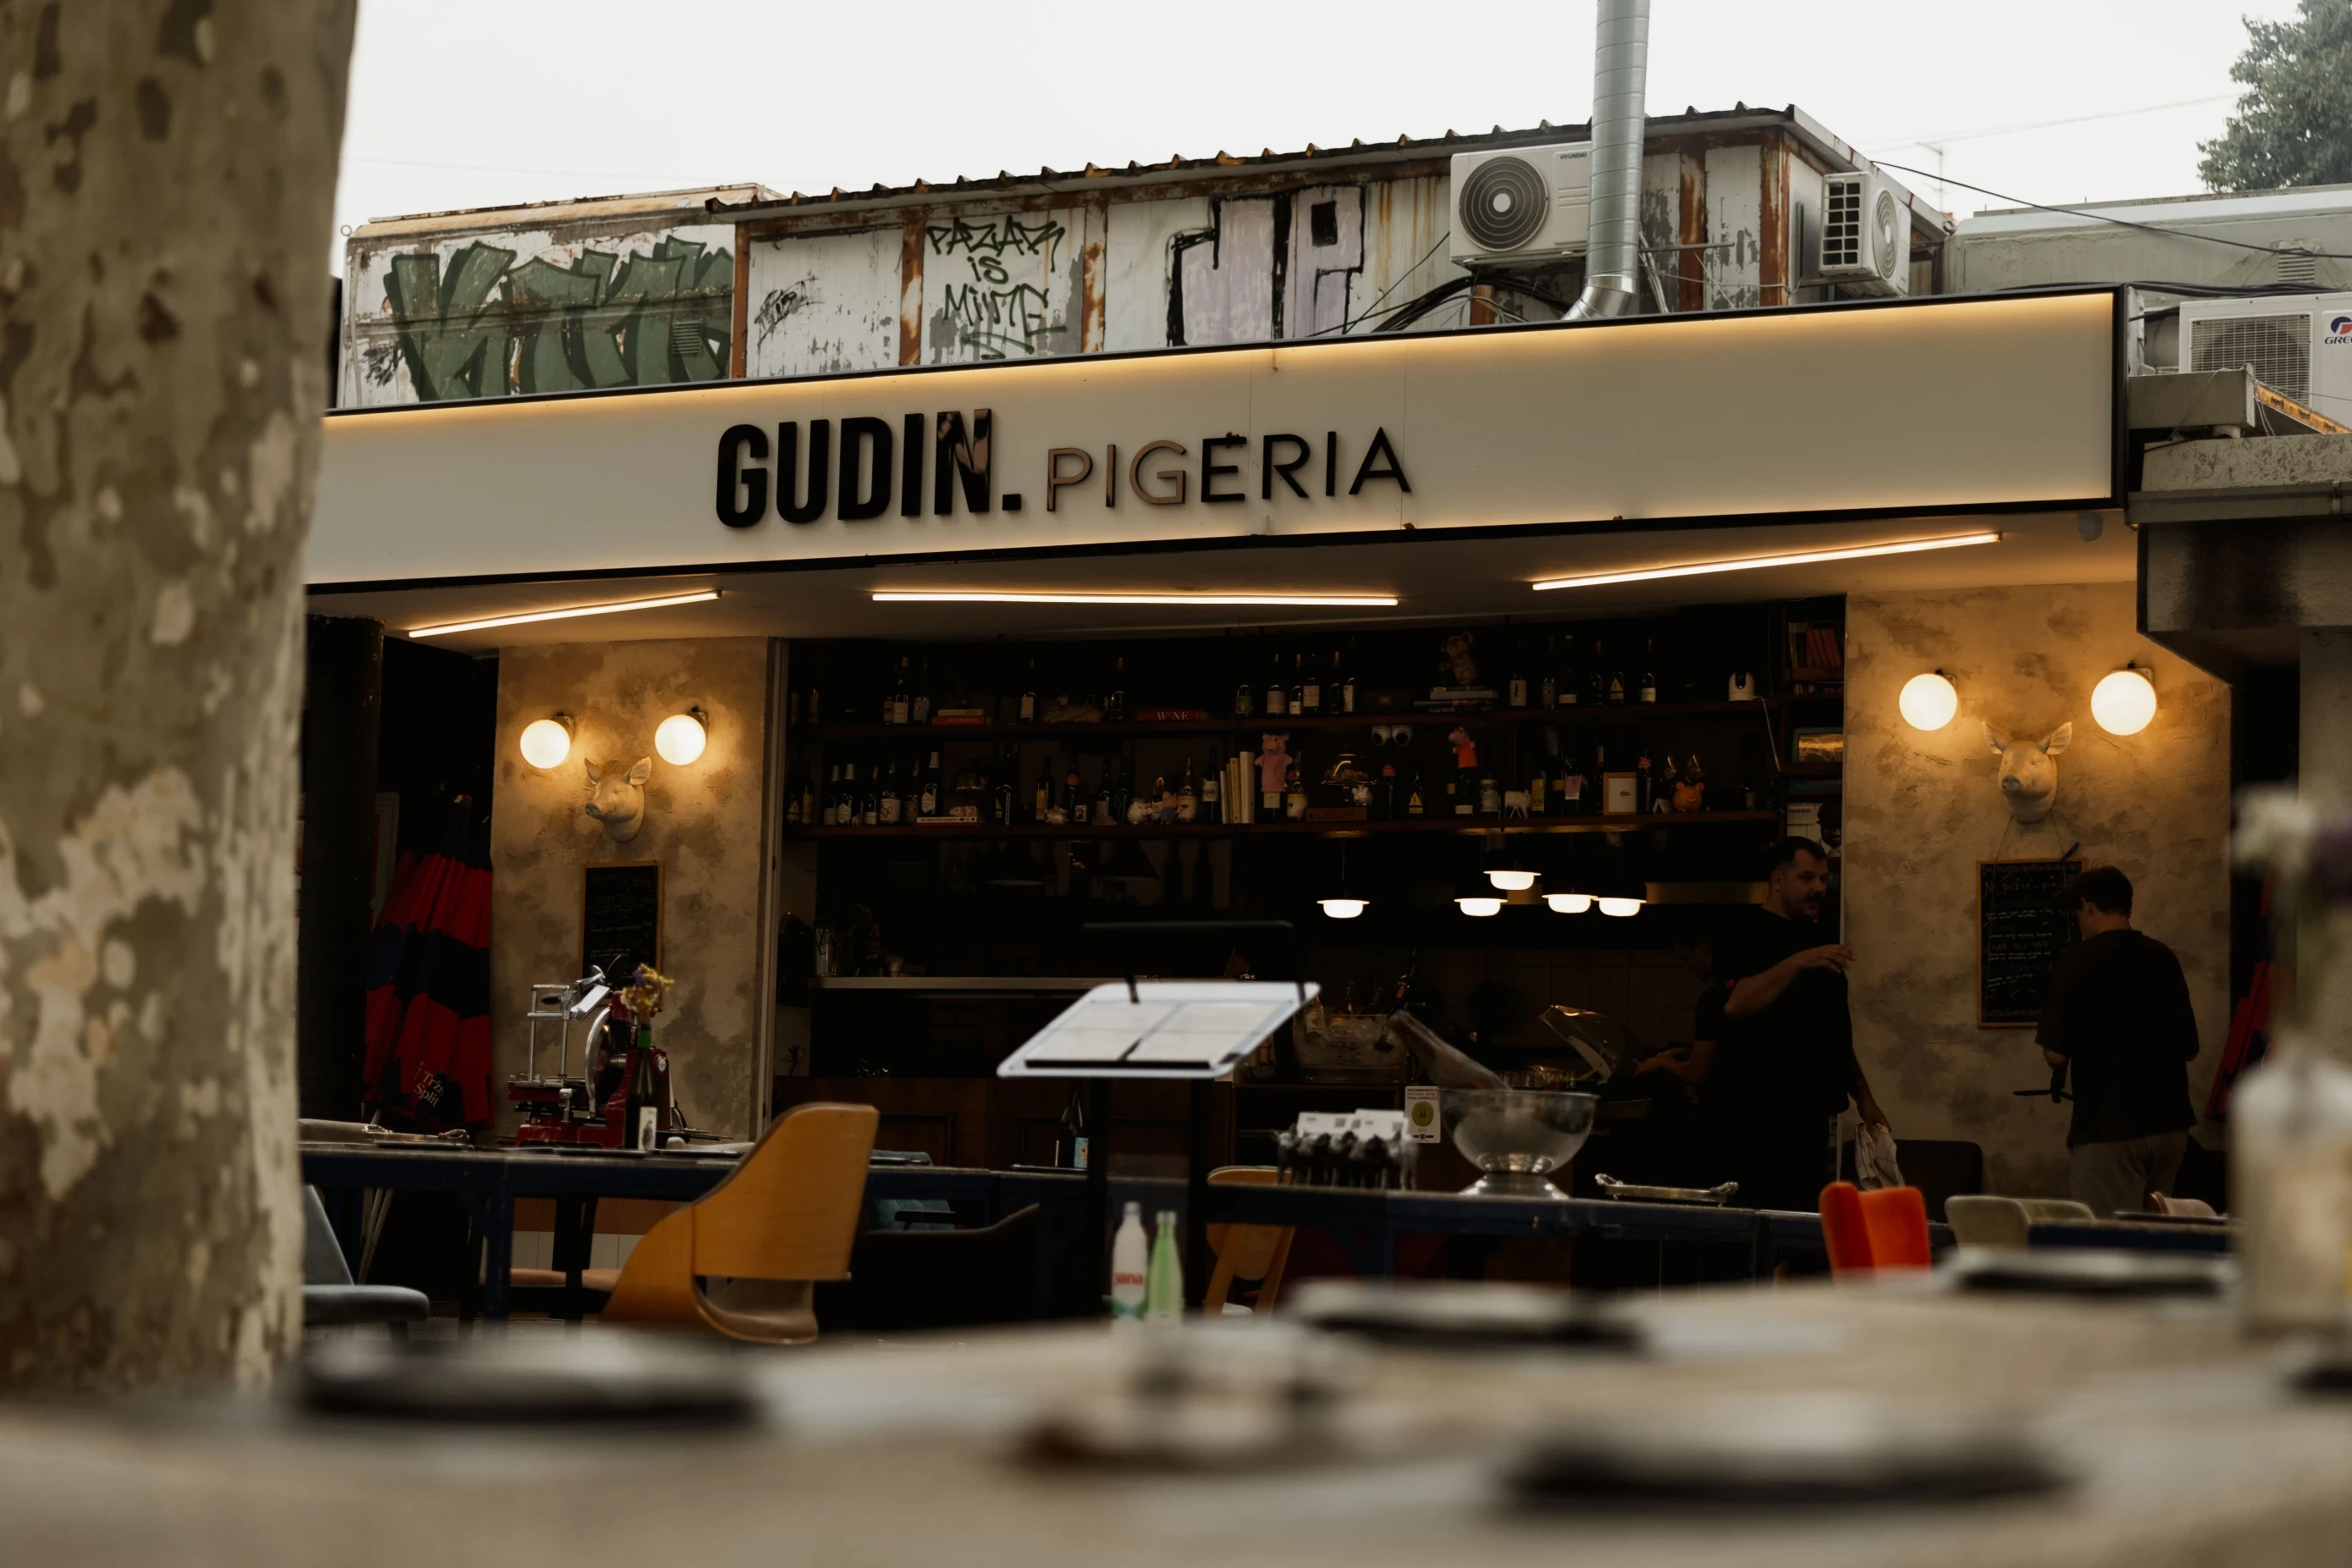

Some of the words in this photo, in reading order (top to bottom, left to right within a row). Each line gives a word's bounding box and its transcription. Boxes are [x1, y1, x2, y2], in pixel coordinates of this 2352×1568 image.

[2324, 335, 2352, 345] GRE
[716, 408, 1022, 528] GUDIN.
[1046, 427, 1412, 512] PIGERIA
[414, 1083, 439, 1108] Split
